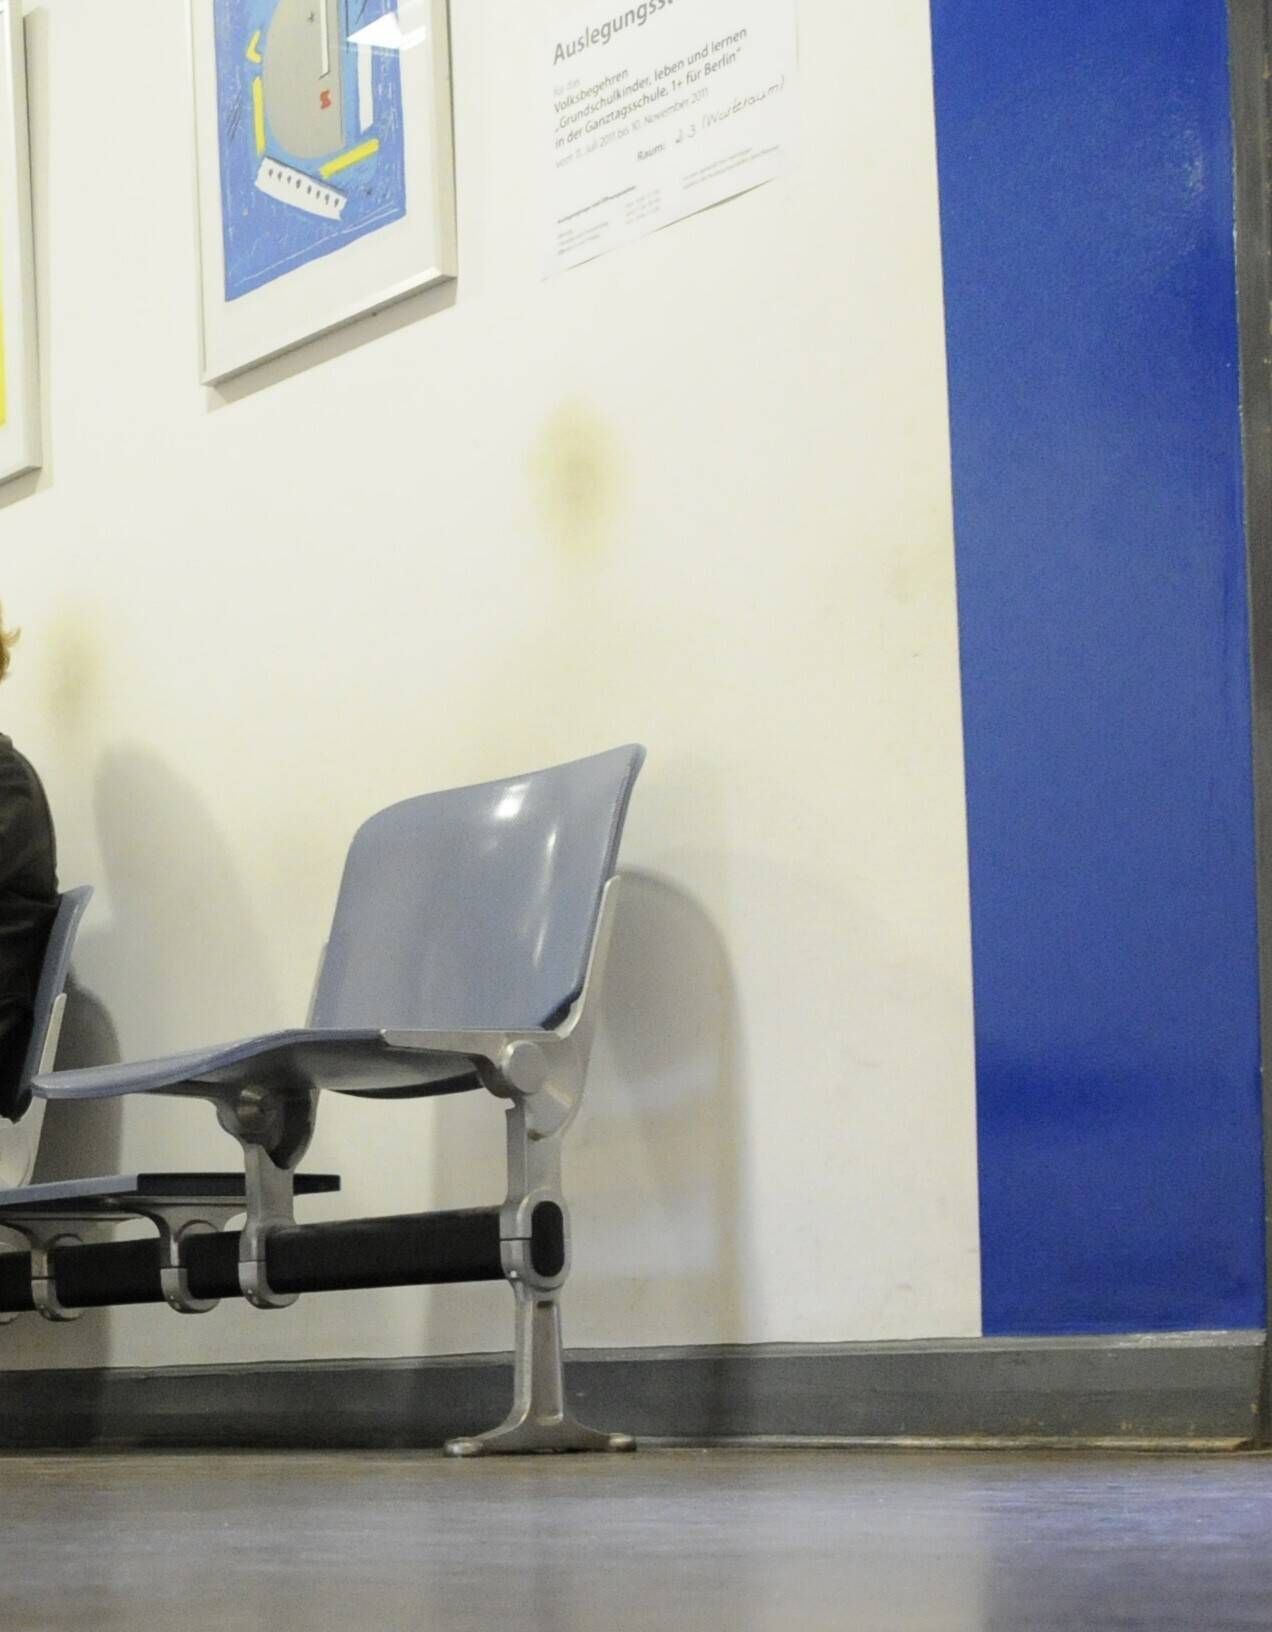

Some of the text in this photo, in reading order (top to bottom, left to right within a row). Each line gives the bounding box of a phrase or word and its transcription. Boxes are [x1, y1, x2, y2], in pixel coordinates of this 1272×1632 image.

[552, 0, 674, 65] Auslegungss
[654, 58, 685, 81] leben
[687, 44, 708, 65] und
[711, 28, 747, 54] lernen
[553, 68, 629, 113] Volksbegehren
[555, 136, 565, 150] in
[567, 127, 583, 144] der
[686, 69, 702, 87] für
